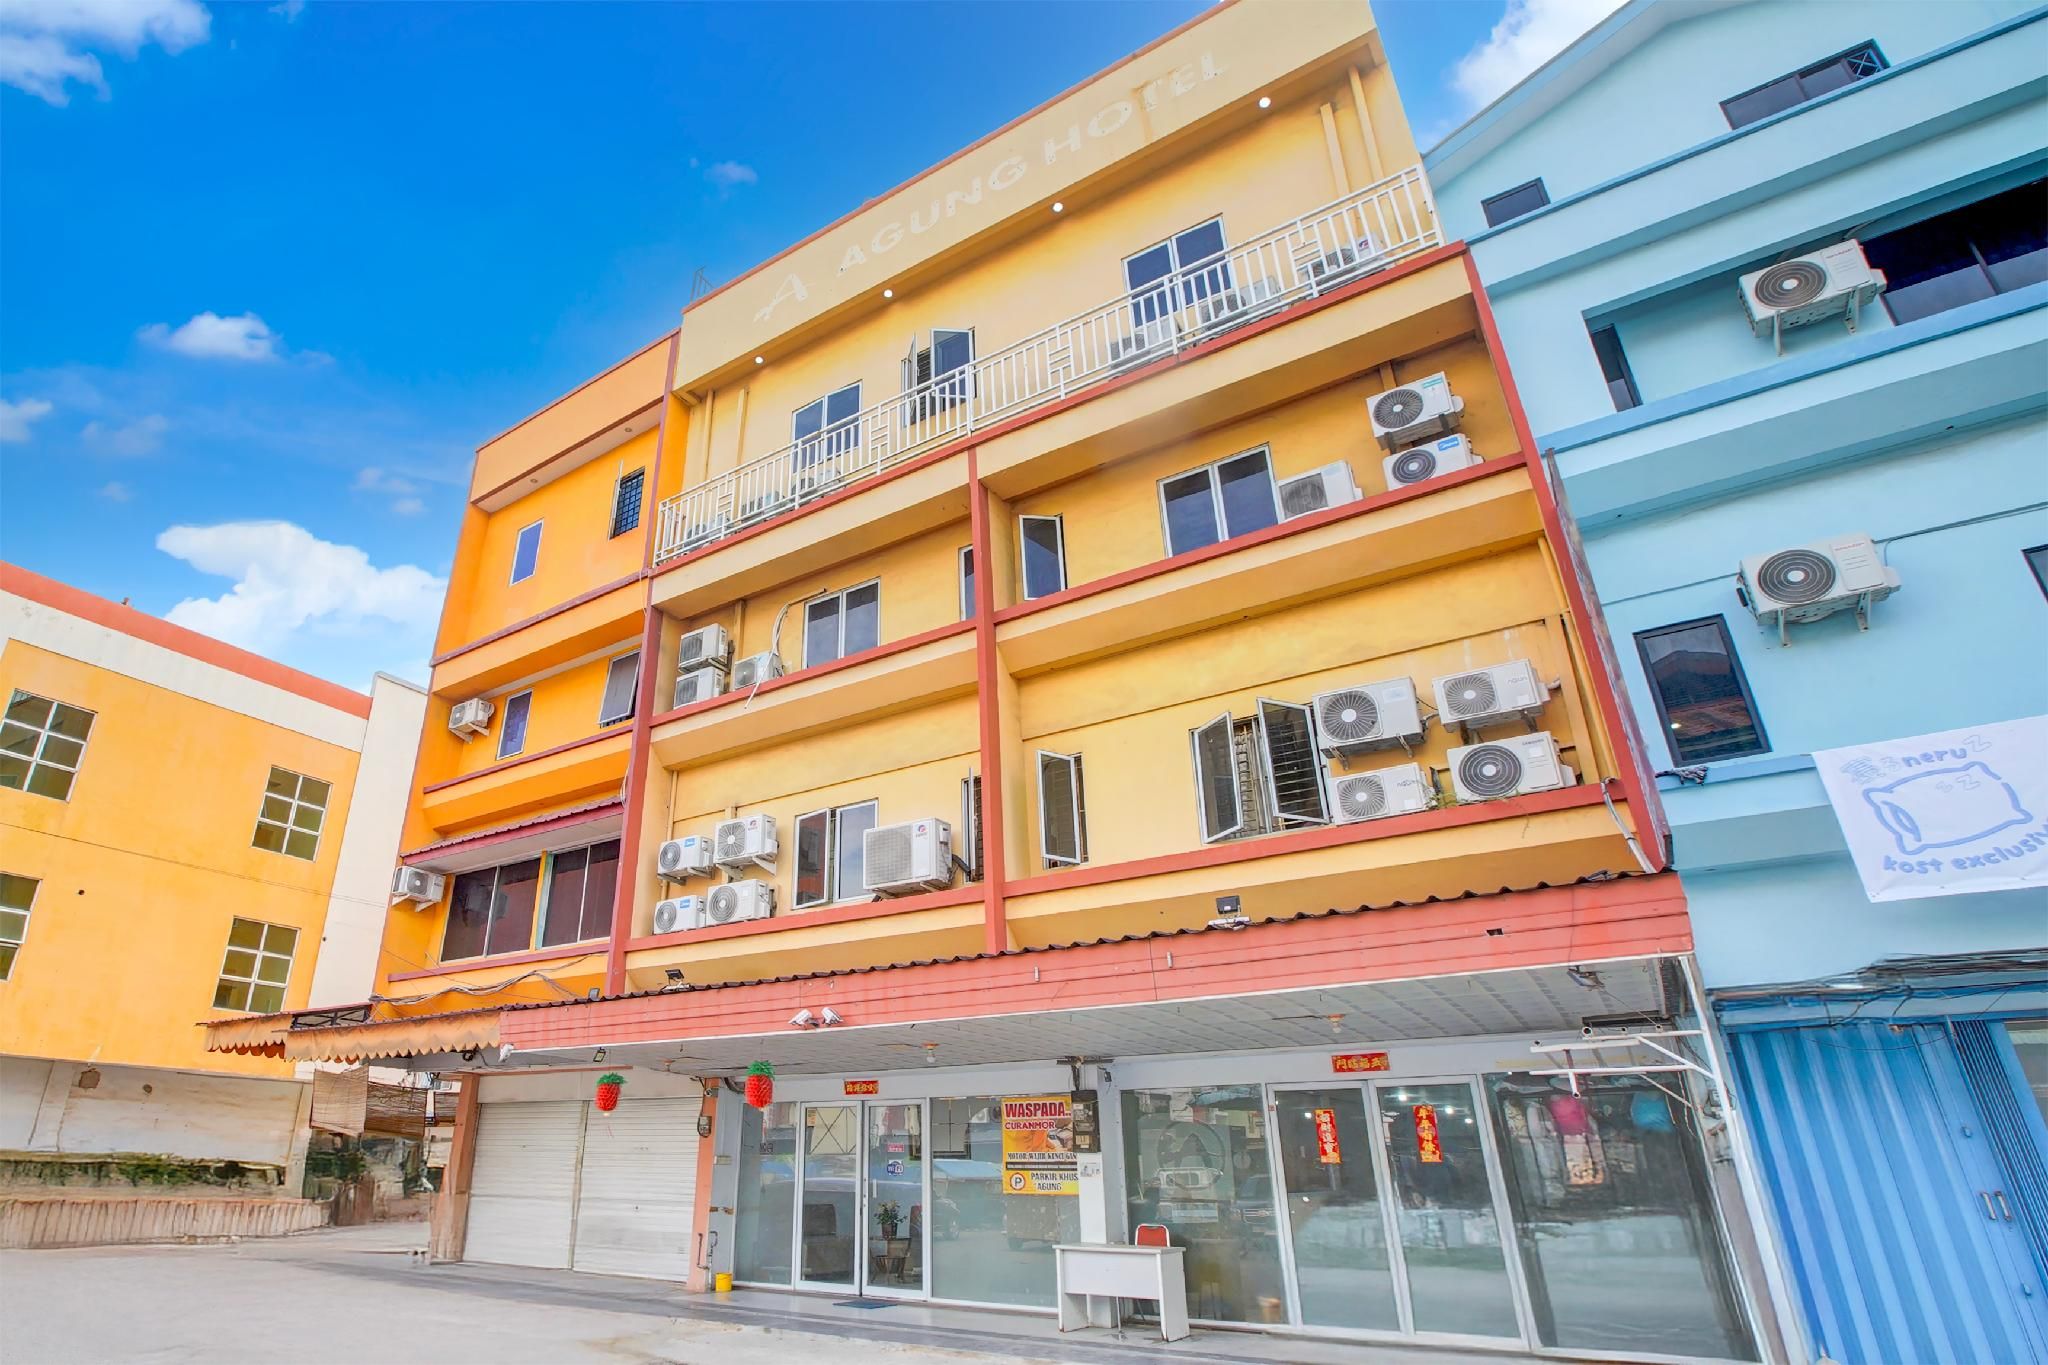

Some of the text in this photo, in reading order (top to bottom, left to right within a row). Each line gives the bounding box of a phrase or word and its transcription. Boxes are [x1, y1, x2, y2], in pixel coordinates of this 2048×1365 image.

[837, 156, 1027, 276] AGUNG
[1044, 51, 1229, 165] HOTEL
[1902, 747, 1968, 768] neru
[1883, 855, 1944, 874] kost
[1005, 1121, 1055, 1130] CURANMOR
[1030, 1172, 1057, 1181] PARKIR
